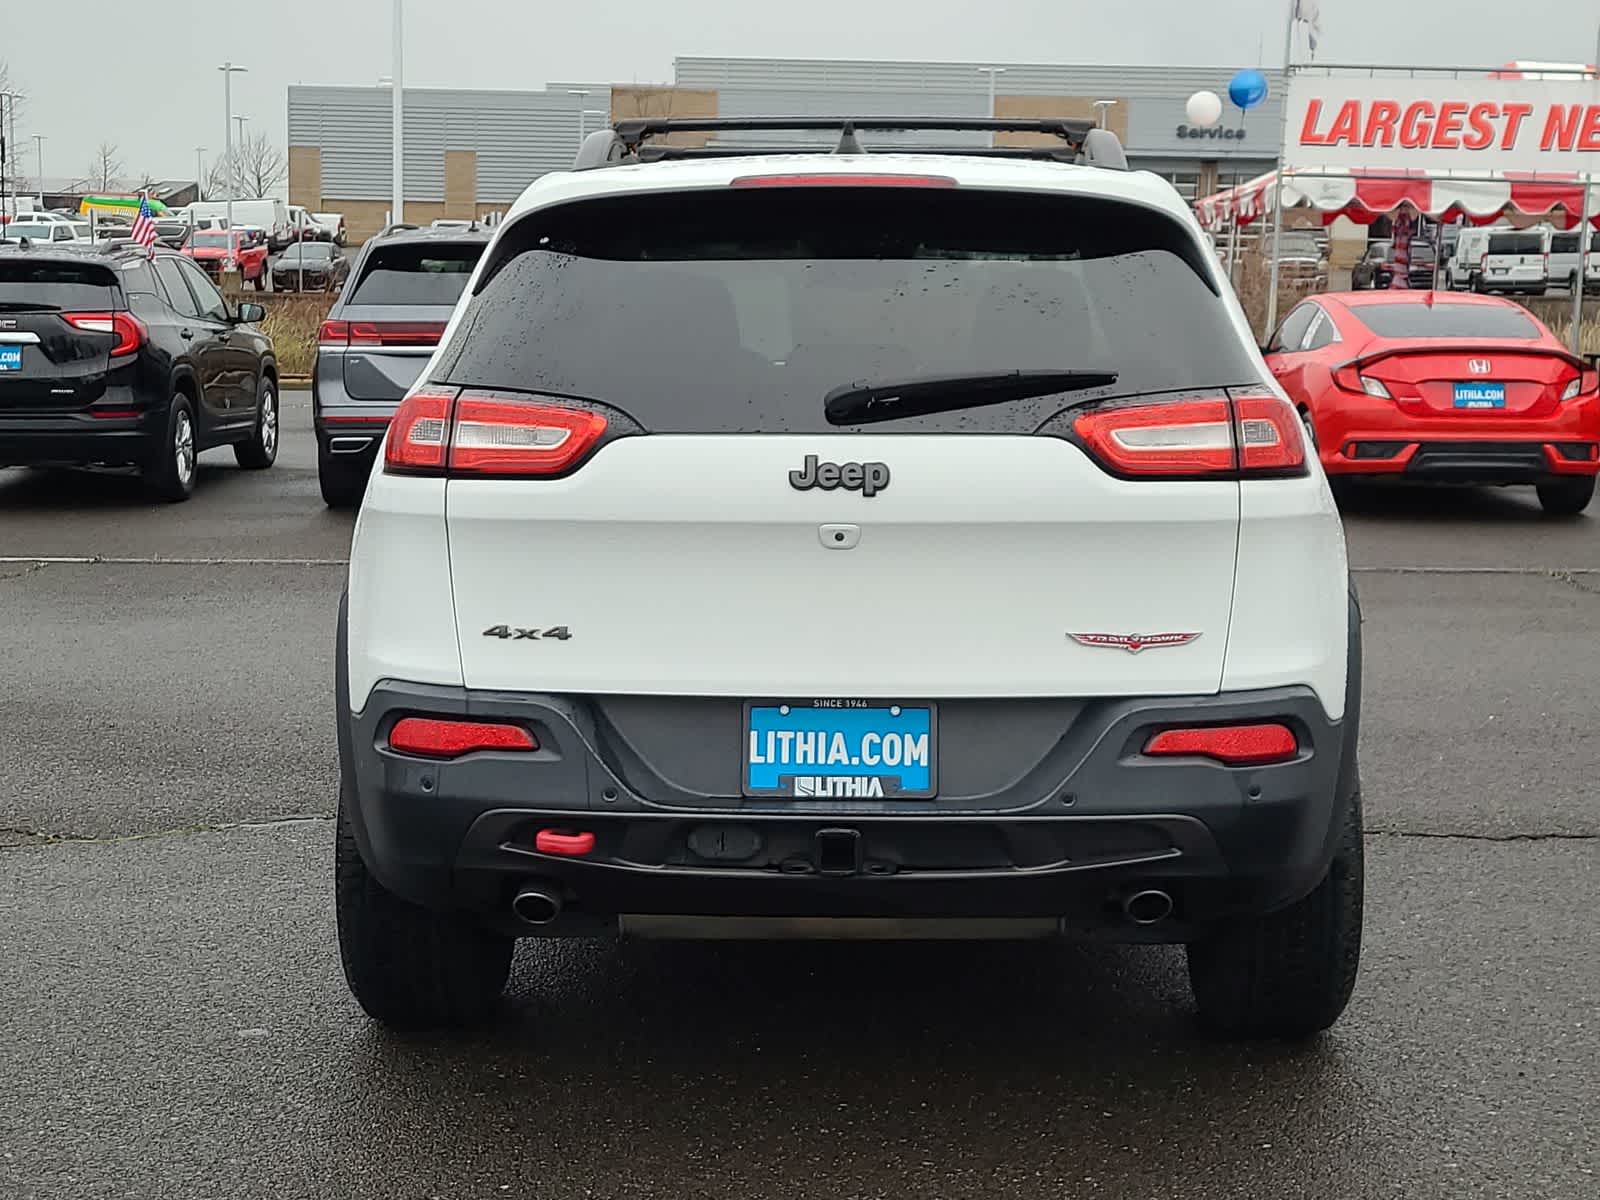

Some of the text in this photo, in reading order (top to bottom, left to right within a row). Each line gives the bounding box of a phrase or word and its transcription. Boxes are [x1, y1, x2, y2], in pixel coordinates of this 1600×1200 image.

[1177, 125, 1245, 139] Service
[1300, 99, 1532, 151] LARGEST
[789, 455, 890, 497] Jeep
[483, 625, 572, 640] 4x4
[813, 699, 868, 708] SINCE 1946
[749, 730, 929, 767] LITHIA.COM
[815, 777, 884, 797] LITHIA
